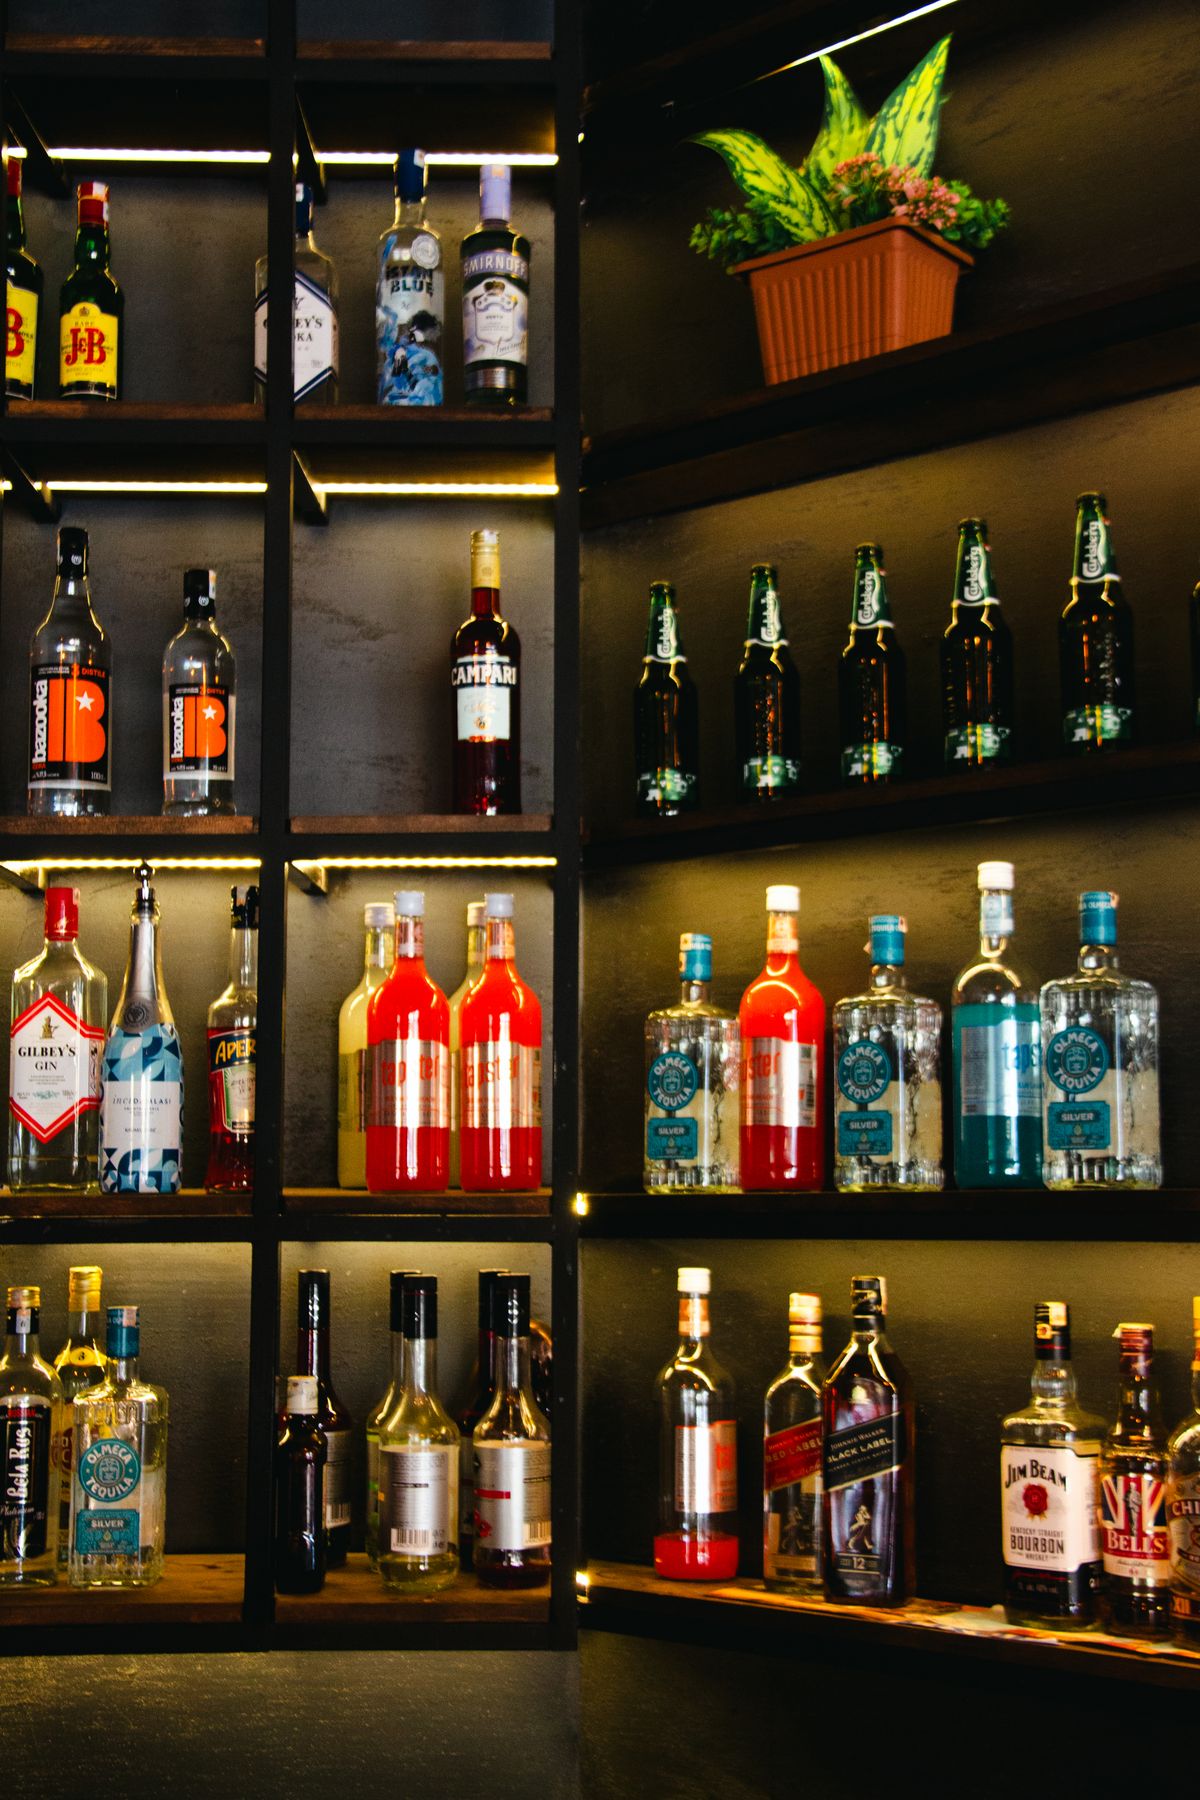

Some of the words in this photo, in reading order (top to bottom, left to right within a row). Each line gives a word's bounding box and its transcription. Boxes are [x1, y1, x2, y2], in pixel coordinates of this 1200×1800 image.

[65, 328, 106, 366] J&B
[1082, 521, 1106, 577] Carlsberg
[964, 546, 987, 600] Carlsberg
[858, 571, 880, 624] Carlsberg
[761, 590, 780, 641] Carlsberg
[657, 608, 677, 658] Carlsberg
[451, 664, 517, 685] CAMPARI
[32, 680, 48, 763] bazooka
[171, 697, 184, 758] bazooka
[18, 1043, 76, 1058] GILBEY'S
[215, 1039, 257, 1065] APER
[1054, 1032, 1099, 1053] OLMECA
[35, 1061, 58, 1071] GIN
[653, 1057, 691, 1076] OLMECA
[843, 1046, 883, 1066] OLMECA
[843, 1078, 884, 1099] TEQUILA
[1054, 1067, 1101, 1089] TEQUILA
[653, 1087, 692, 1107] TEQUILA
[849, 1121, 878, 1129] SILVER
[1061, 1112, 1094, 1121] SILVER
[658, 1127, 685, 1135] SILVER
[87, 1444, 132, 1465] OLMECA
[86, 1476, 133, 1498] TEQUILA
[91, 1519, 124, 1528] SILVER
[1010, 1534, 1064, 1554] BOURBON
[853, 1557, 865, 1569] 12
